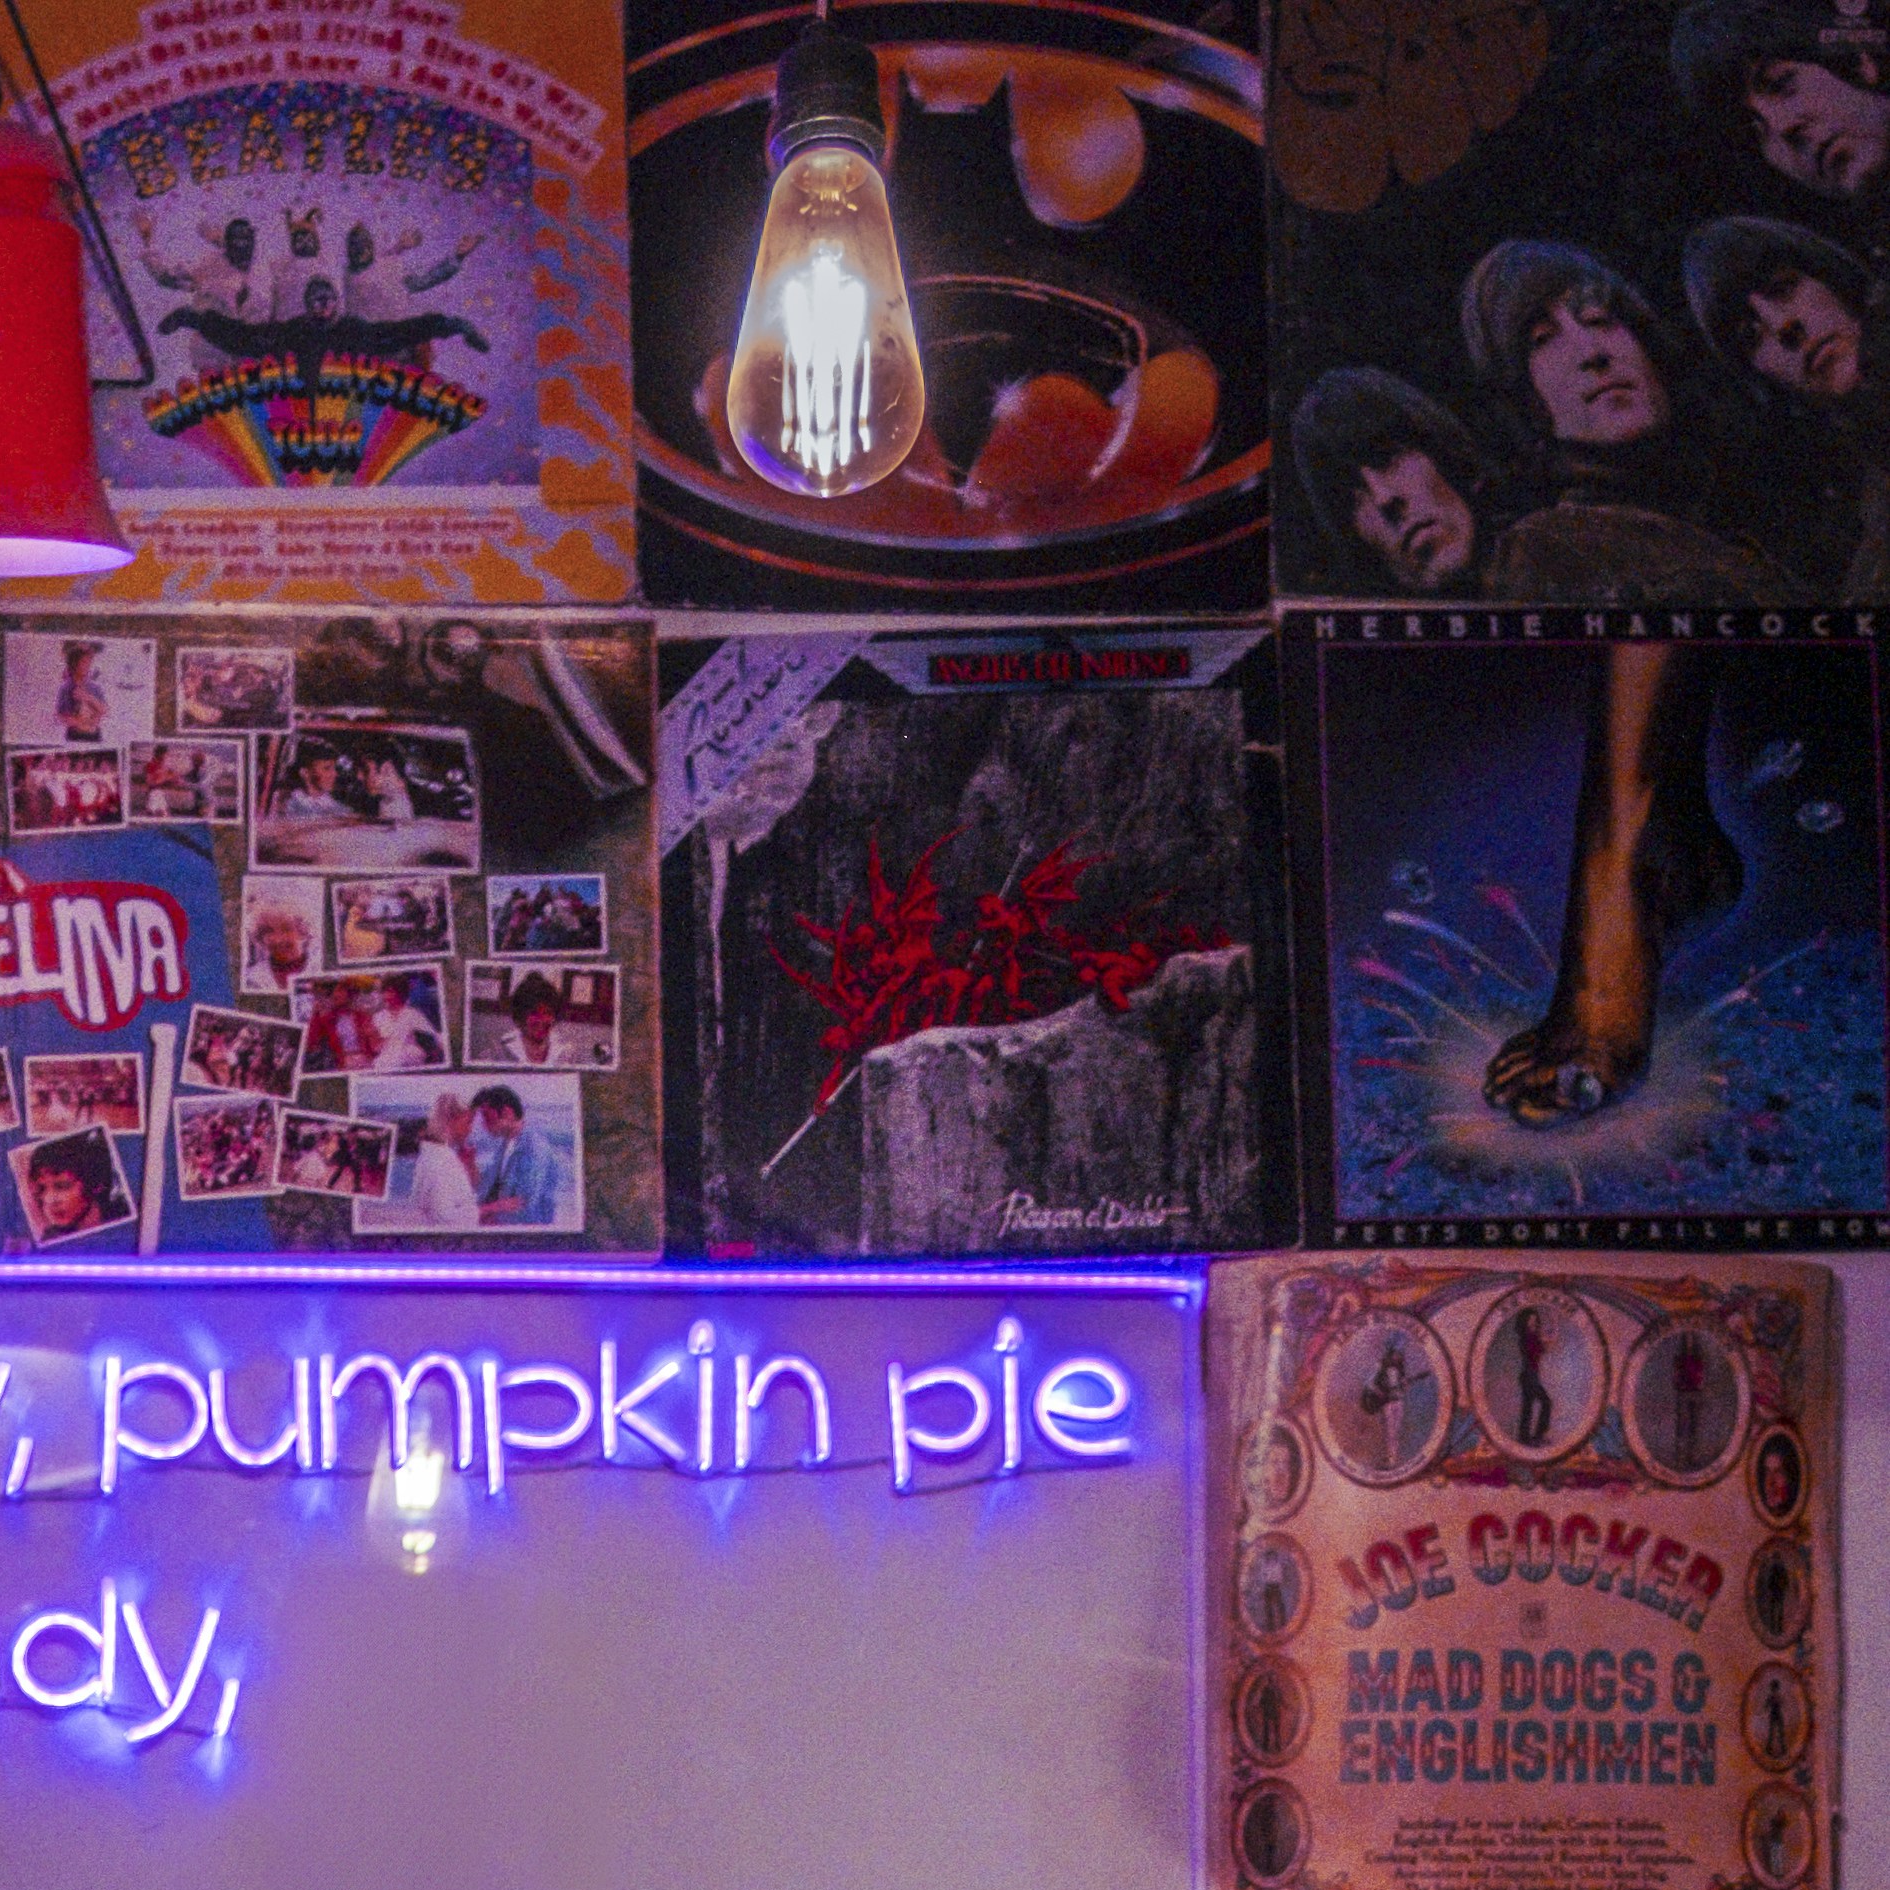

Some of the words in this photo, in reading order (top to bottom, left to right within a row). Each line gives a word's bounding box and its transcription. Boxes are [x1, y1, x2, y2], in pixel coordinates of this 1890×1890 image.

[121, 110, 488, 198] BEATLES
[142, 350, 307, 438] MAGICAL
[1314, 614, 1544, 640] HERBIE
[1583, 613, 1877, 640] HANCOCK
[1332, 1221, 1459, 1244] FEETS
[1483, 1220, 1591, 1243] DON'T
[1616, 1220, 1715, 1241] FAIL
[1731, 1218, 1792, 1240] ME
[99, 1317, 834, 1500] pumpkin
[886, 1314, 1134, 1496] pie
[1337, 1523, 1455, 1630] JOE
[1467, 1508, 1726, 1634] COCKER
[1346, 1648, 1485, 1713] MAD
[1499, 1649, 1658, 1713] DOGS
[1672, 1649, 1712, 1712] &
[1338, 1718, 1718, 1786] ENGLISHMEN
